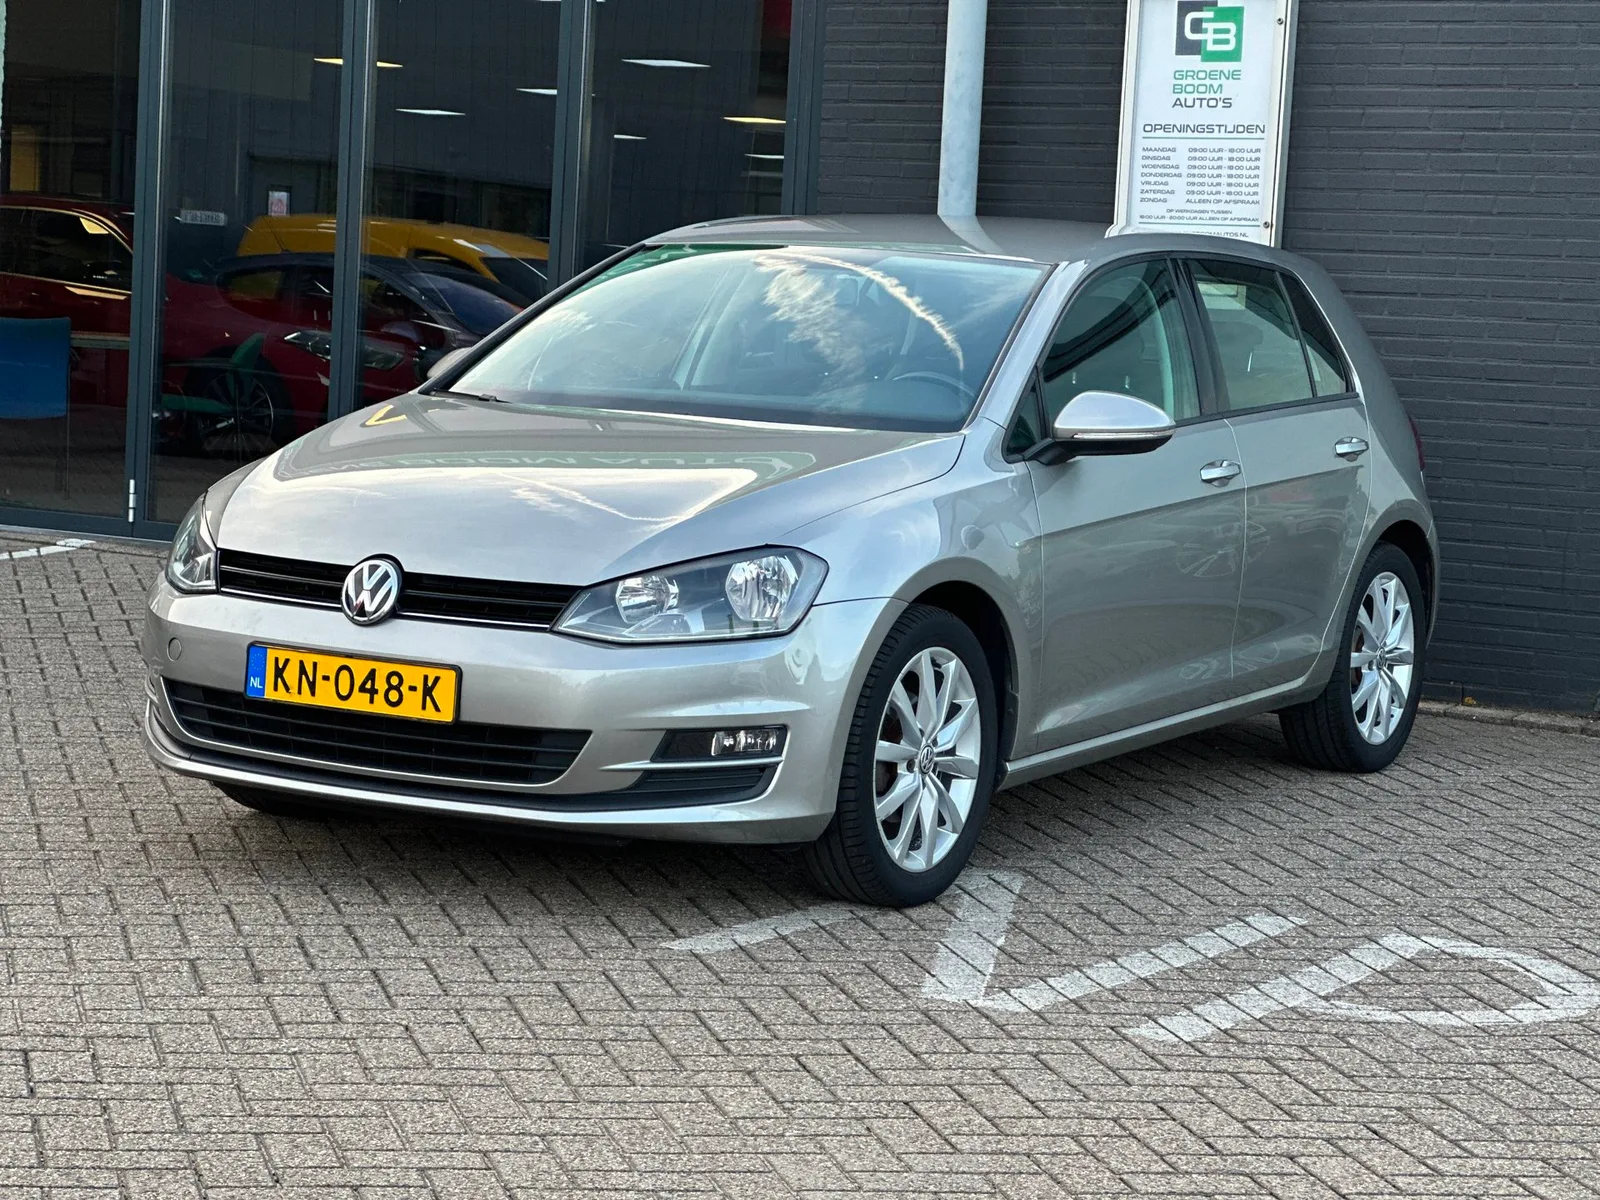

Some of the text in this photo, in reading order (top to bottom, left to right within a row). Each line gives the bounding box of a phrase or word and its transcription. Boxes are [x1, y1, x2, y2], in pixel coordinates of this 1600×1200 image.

[1173, 69, 1242, 81] GROENE
[1172, 83, 1223, 94] BOOM
[1172, 97, 1233, 108] AUTO'S
[1142, 123, 1266, 134] OPENINGSTIJDEN
[250, 676, 263, 689] NL
[273, 656, 442, 713] KN-048-K
